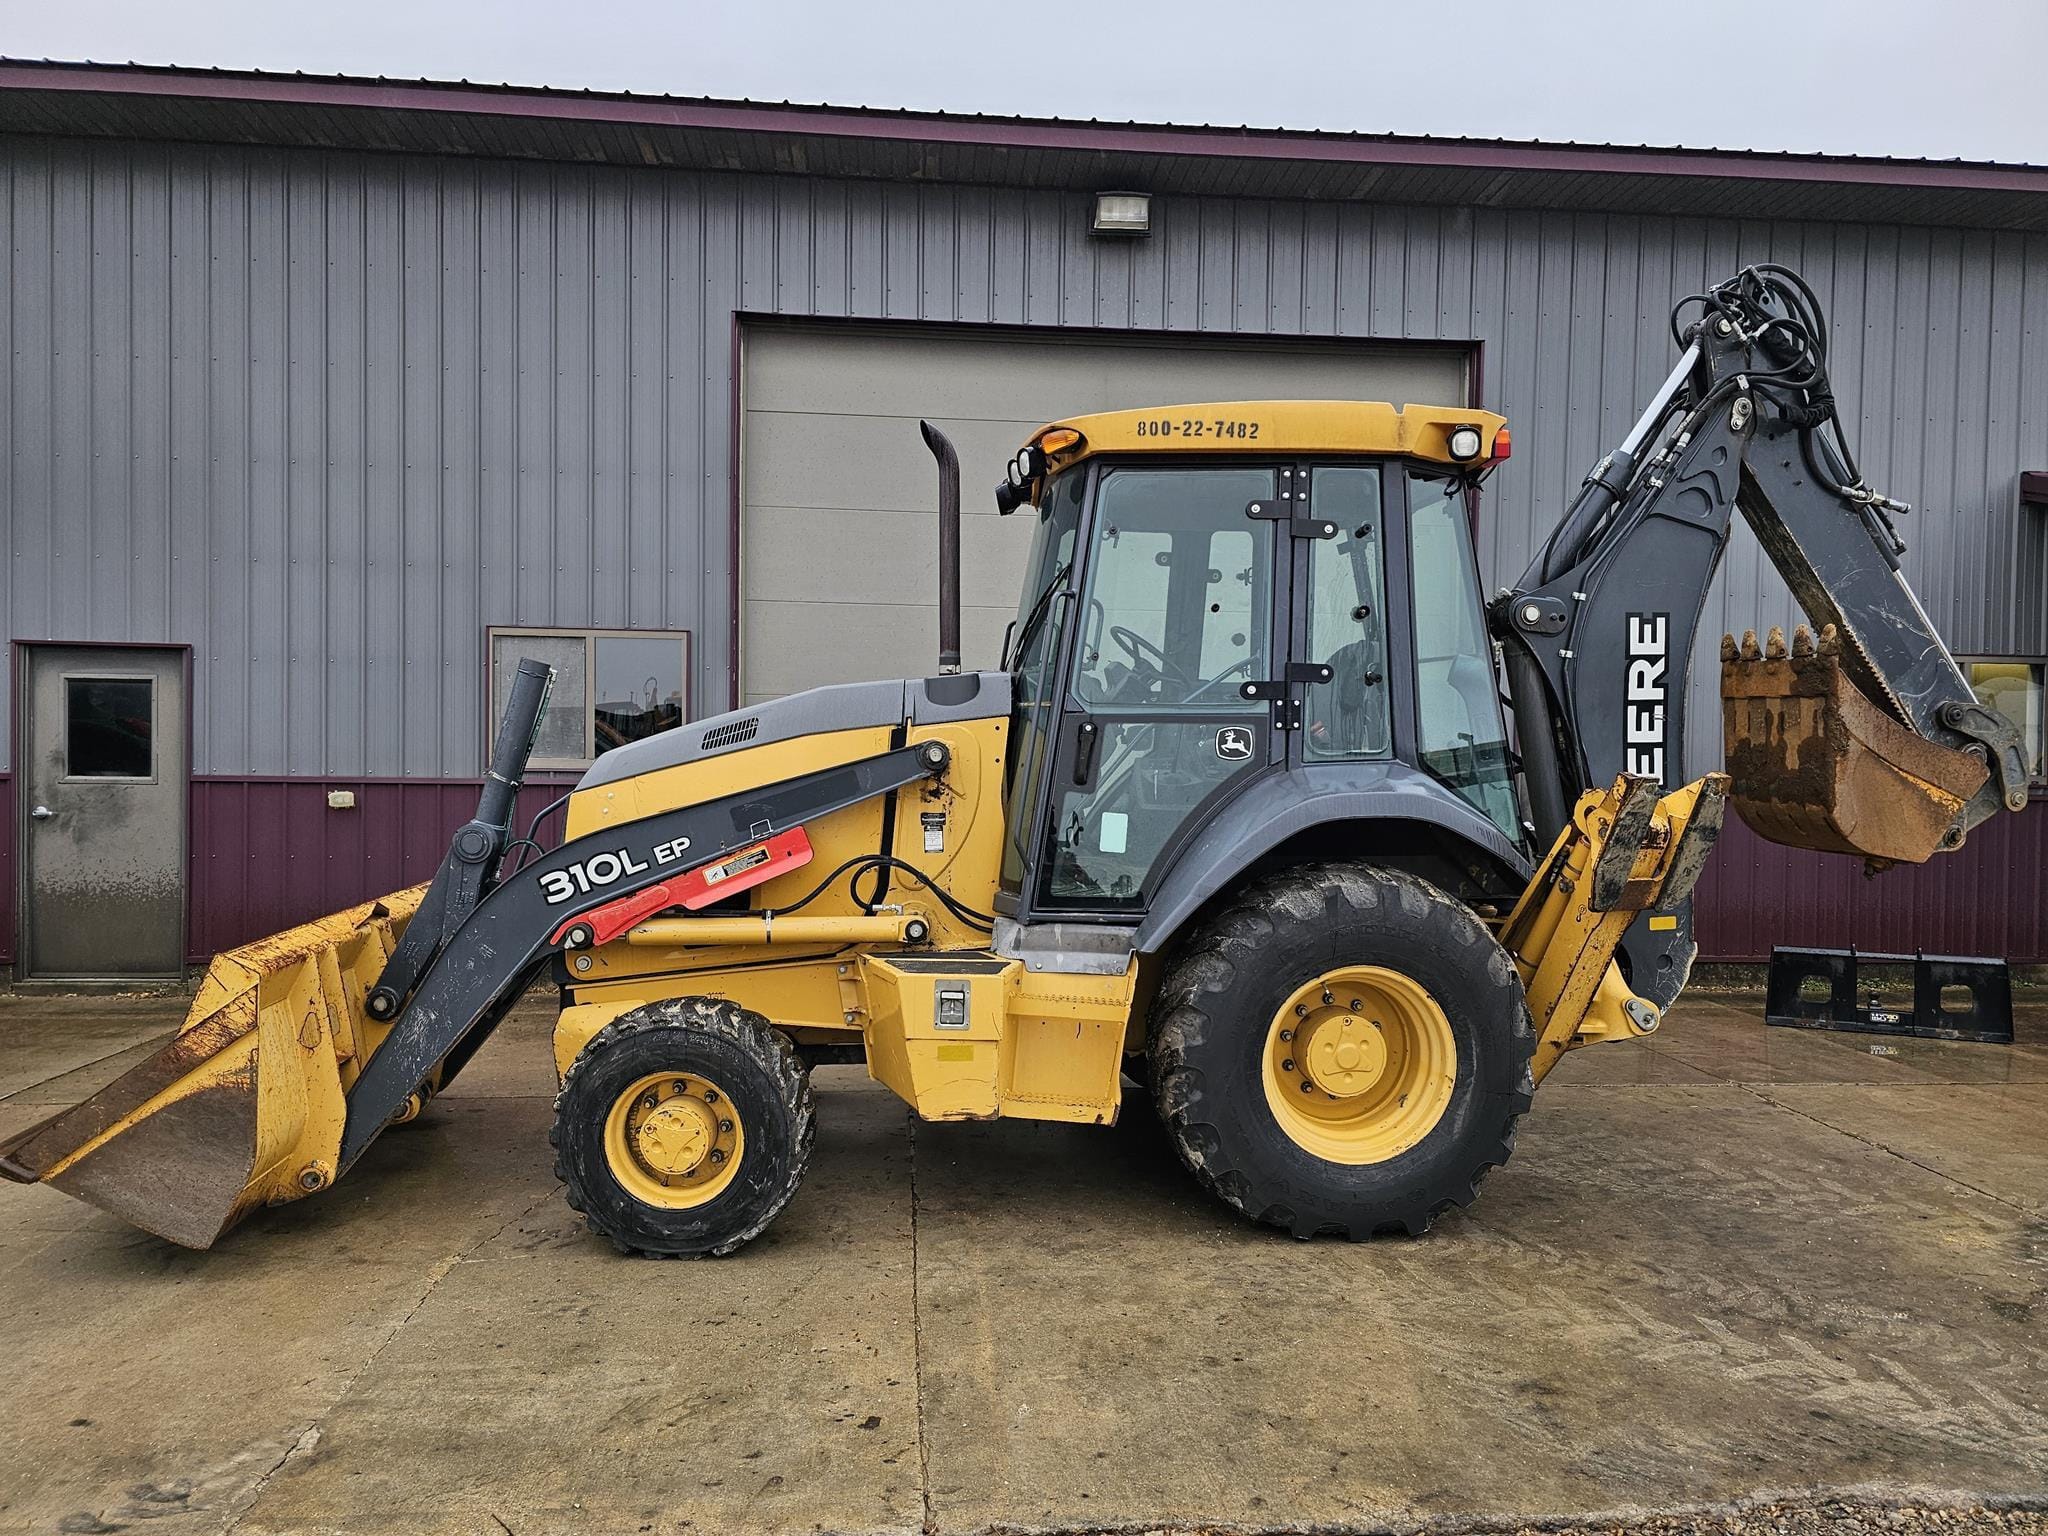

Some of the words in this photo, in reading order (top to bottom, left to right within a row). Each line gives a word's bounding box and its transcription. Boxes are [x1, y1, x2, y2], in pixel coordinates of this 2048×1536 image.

[1137, 420, 1259, 439] 800-22-7482
[1627, 617, 1666, 786] EERE
[539, 849, 648, 904] 310L
[653, 836, 691, 865] EP
